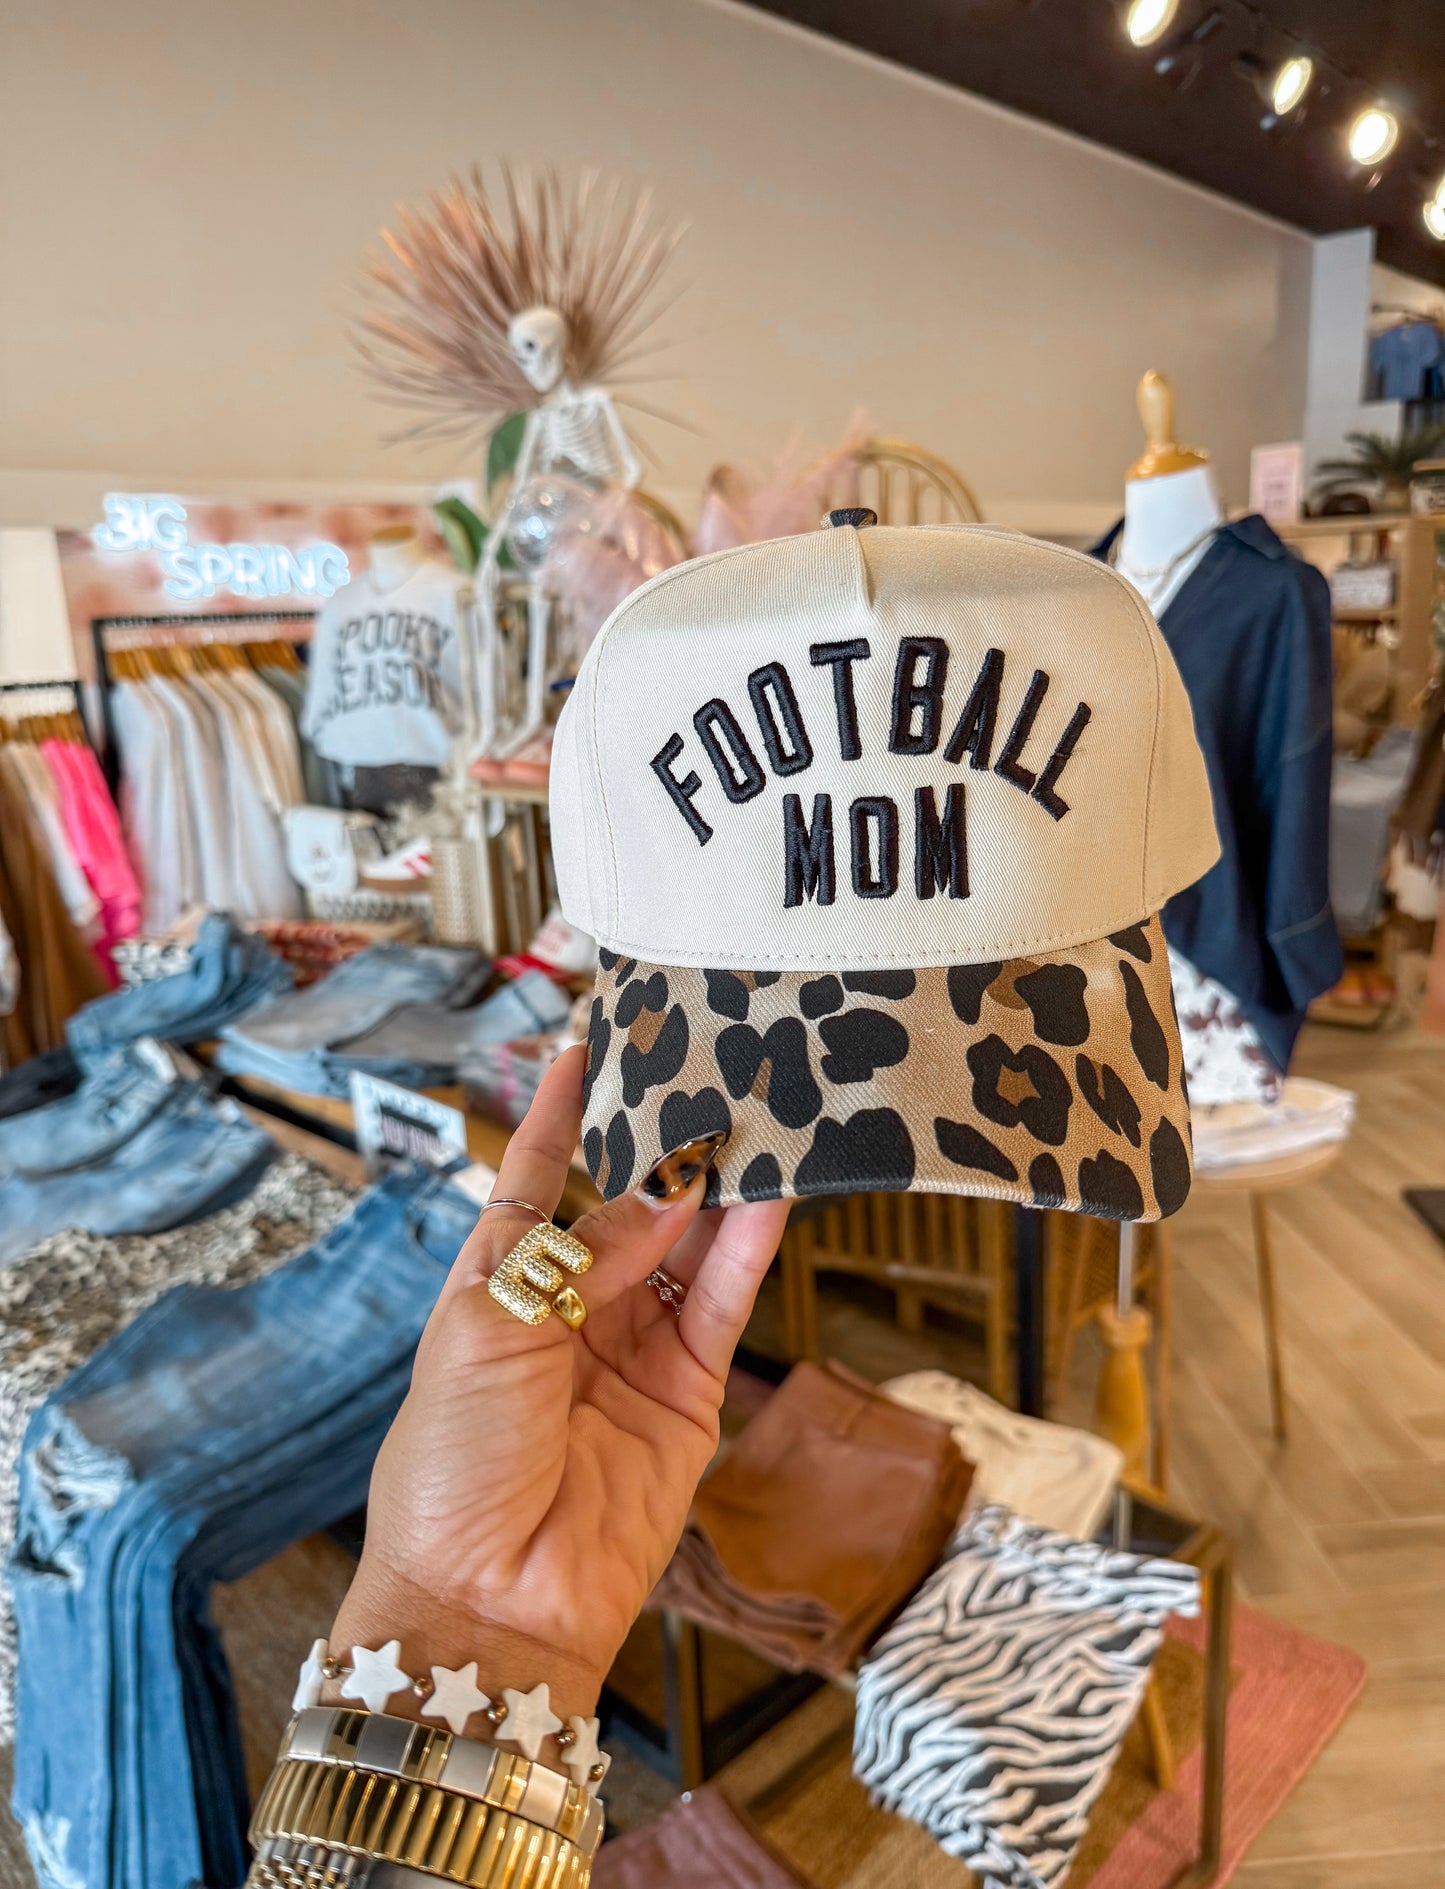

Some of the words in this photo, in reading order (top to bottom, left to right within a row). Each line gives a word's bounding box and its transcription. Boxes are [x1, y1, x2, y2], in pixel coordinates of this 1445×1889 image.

[163, 543, 350, 599] SPRING
[650, 636, 1092, 847] FOOTBALL
[783, 783, 970, 908] MOM
